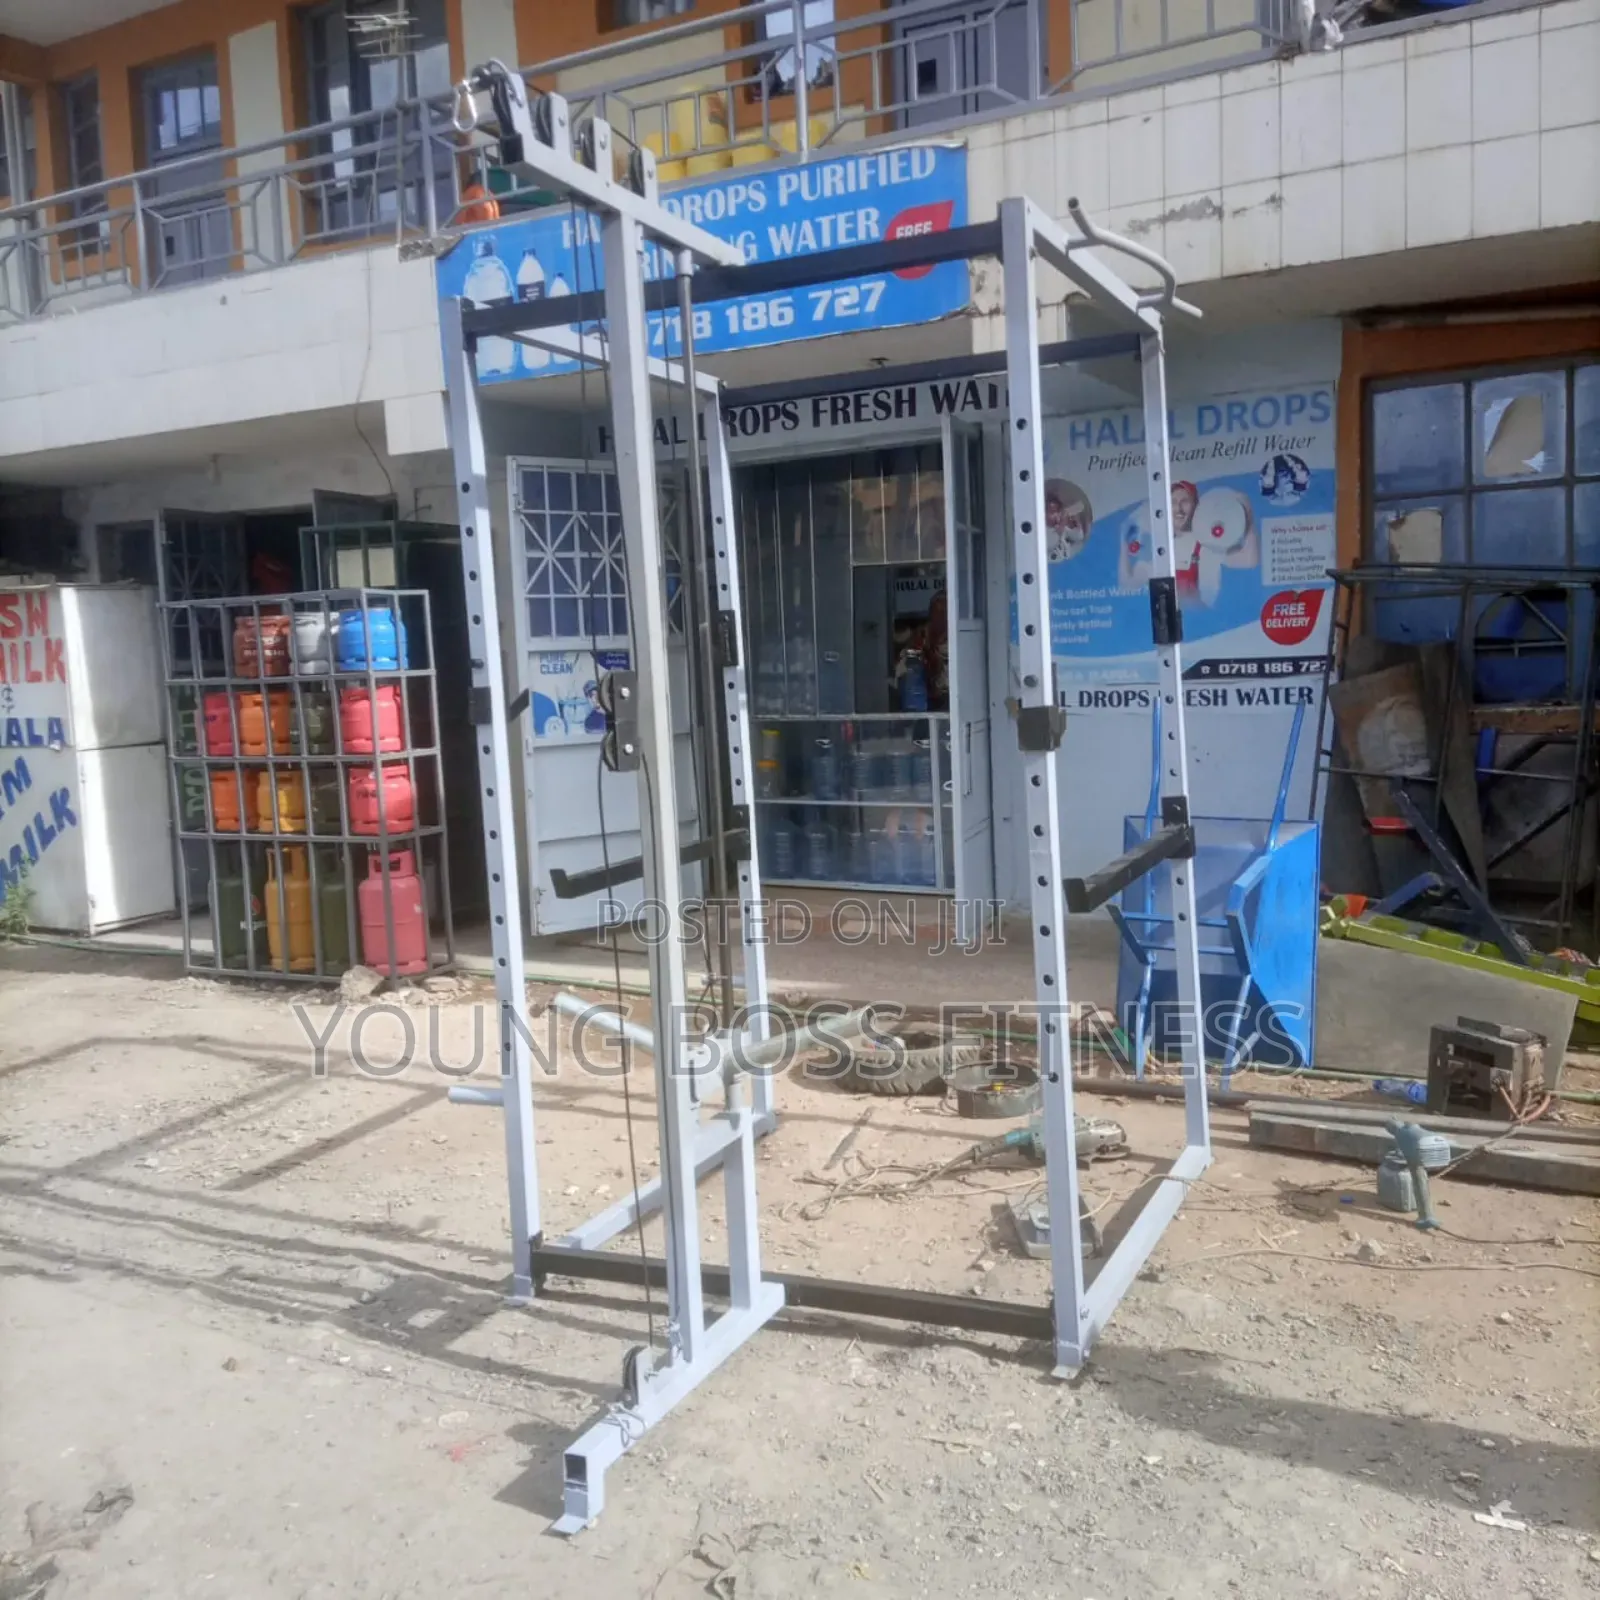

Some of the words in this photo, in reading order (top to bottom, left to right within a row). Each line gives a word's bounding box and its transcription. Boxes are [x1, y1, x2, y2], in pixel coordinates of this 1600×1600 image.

[777, 147, 936, 207] PURIFIED
[768, 206, 880, 257] WATER
[645, 308, 713, 346] 718
[726, 296, 795, 334] 186
[808, 280, 887, 322] 727
[698, 400, 800, 441] ROPS
[811, 387, 917, 428] FRESH
[1069, 409, 1185, 450] HALL
[1197, 390, 1332, 437] DROPS
[1167, 445, 1207, 465] lean
[1211, 434, 1259, 461] Refill
[1263, 430, 1317, 452] Water
[1266, 617, 1310, 629] DELIVERY
[1273, 603, 1305, 617] FREE
[0, 637, 66, 684] ILK
[1218, 662, 1258, 674] 0718
[1264, 661, 1293, 673] 186
[1079, 690, 1150, 708] DROPS
[1236, 686, 1314, 706] WATER
[0, 716, 66, 748] ALA
